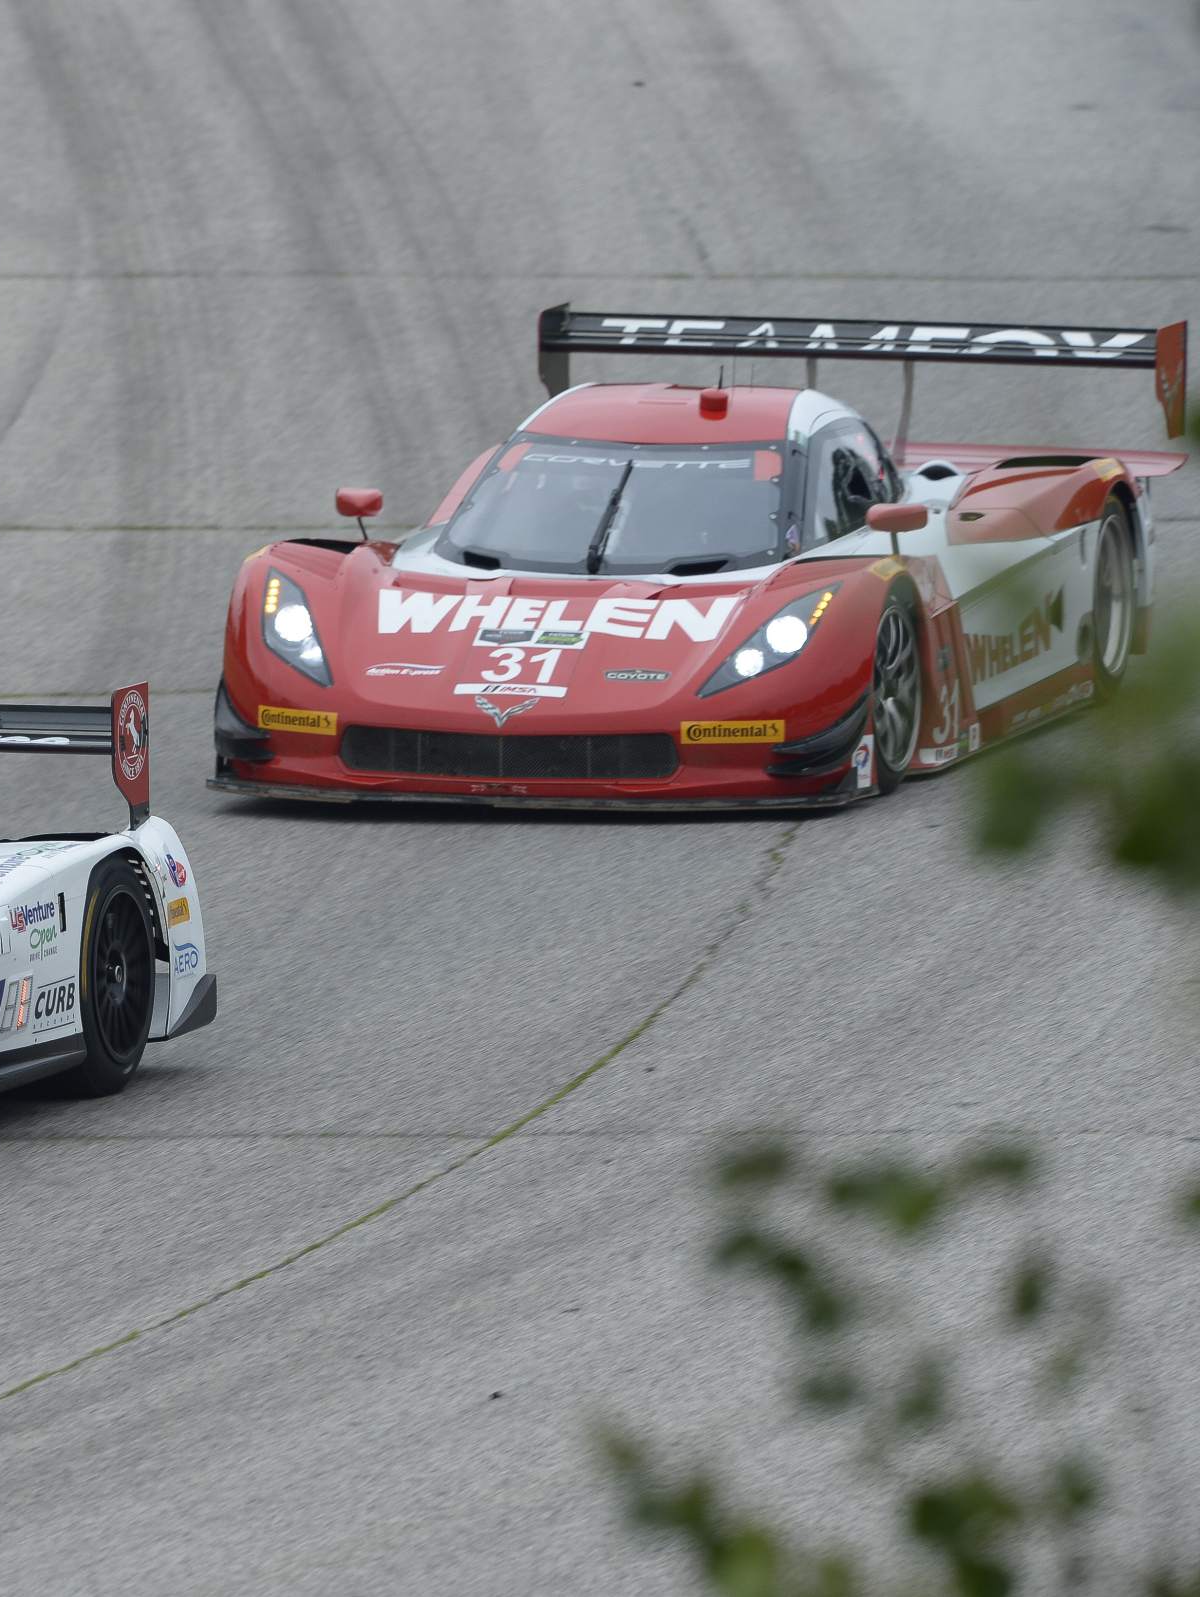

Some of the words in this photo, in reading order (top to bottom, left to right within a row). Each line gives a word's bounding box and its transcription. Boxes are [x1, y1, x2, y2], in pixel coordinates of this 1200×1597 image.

[523, 453, 752, 469] CORVETTE
[378, 588, 742, 643] WHELEN
[480, 646, 563, 684] 31
[606, 672, 667, 680] COYOTE
[261, 709, 321, 728] Continental
[932, 679, 961, 745] 31
[687, 724, 767, 742] Continental
[34, 982, 76, 1020] CURB
